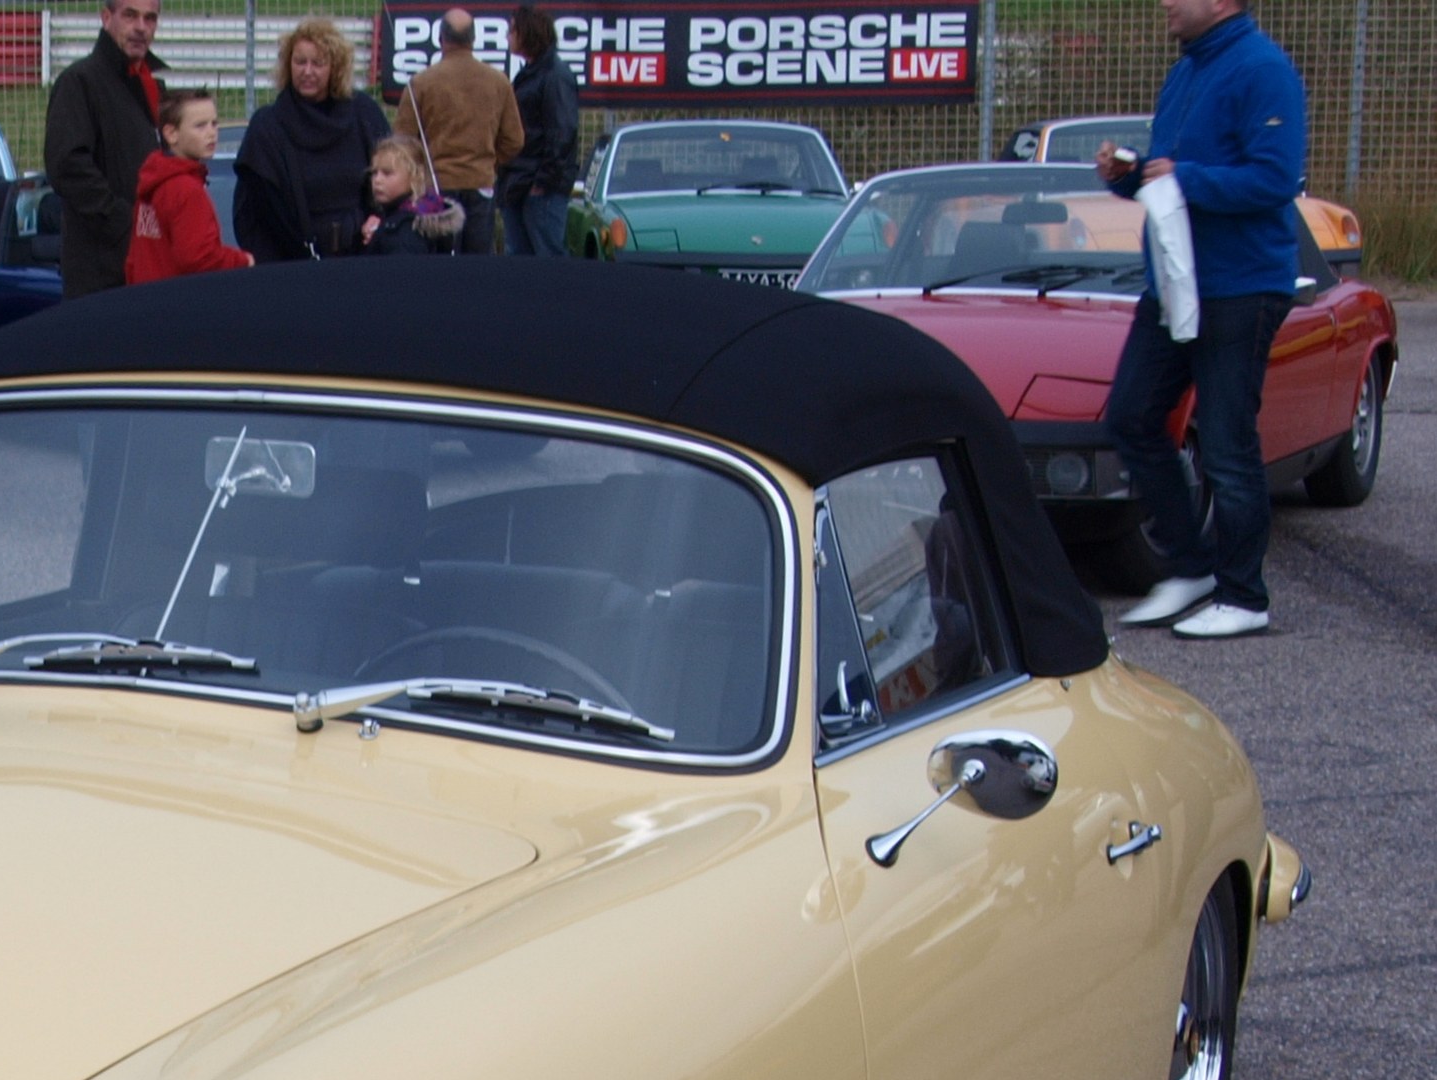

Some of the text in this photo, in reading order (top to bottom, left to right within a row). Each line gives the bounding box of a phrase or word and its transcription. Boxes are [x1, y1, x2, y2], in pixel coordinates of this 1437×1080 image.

[394, 17, 665, 52] PRCHE
[689, 13, 966, 50] PORSCHE
[593, 56, 657, 82] LIVE
[687, 49, 958, 86] SCENE LIVE
